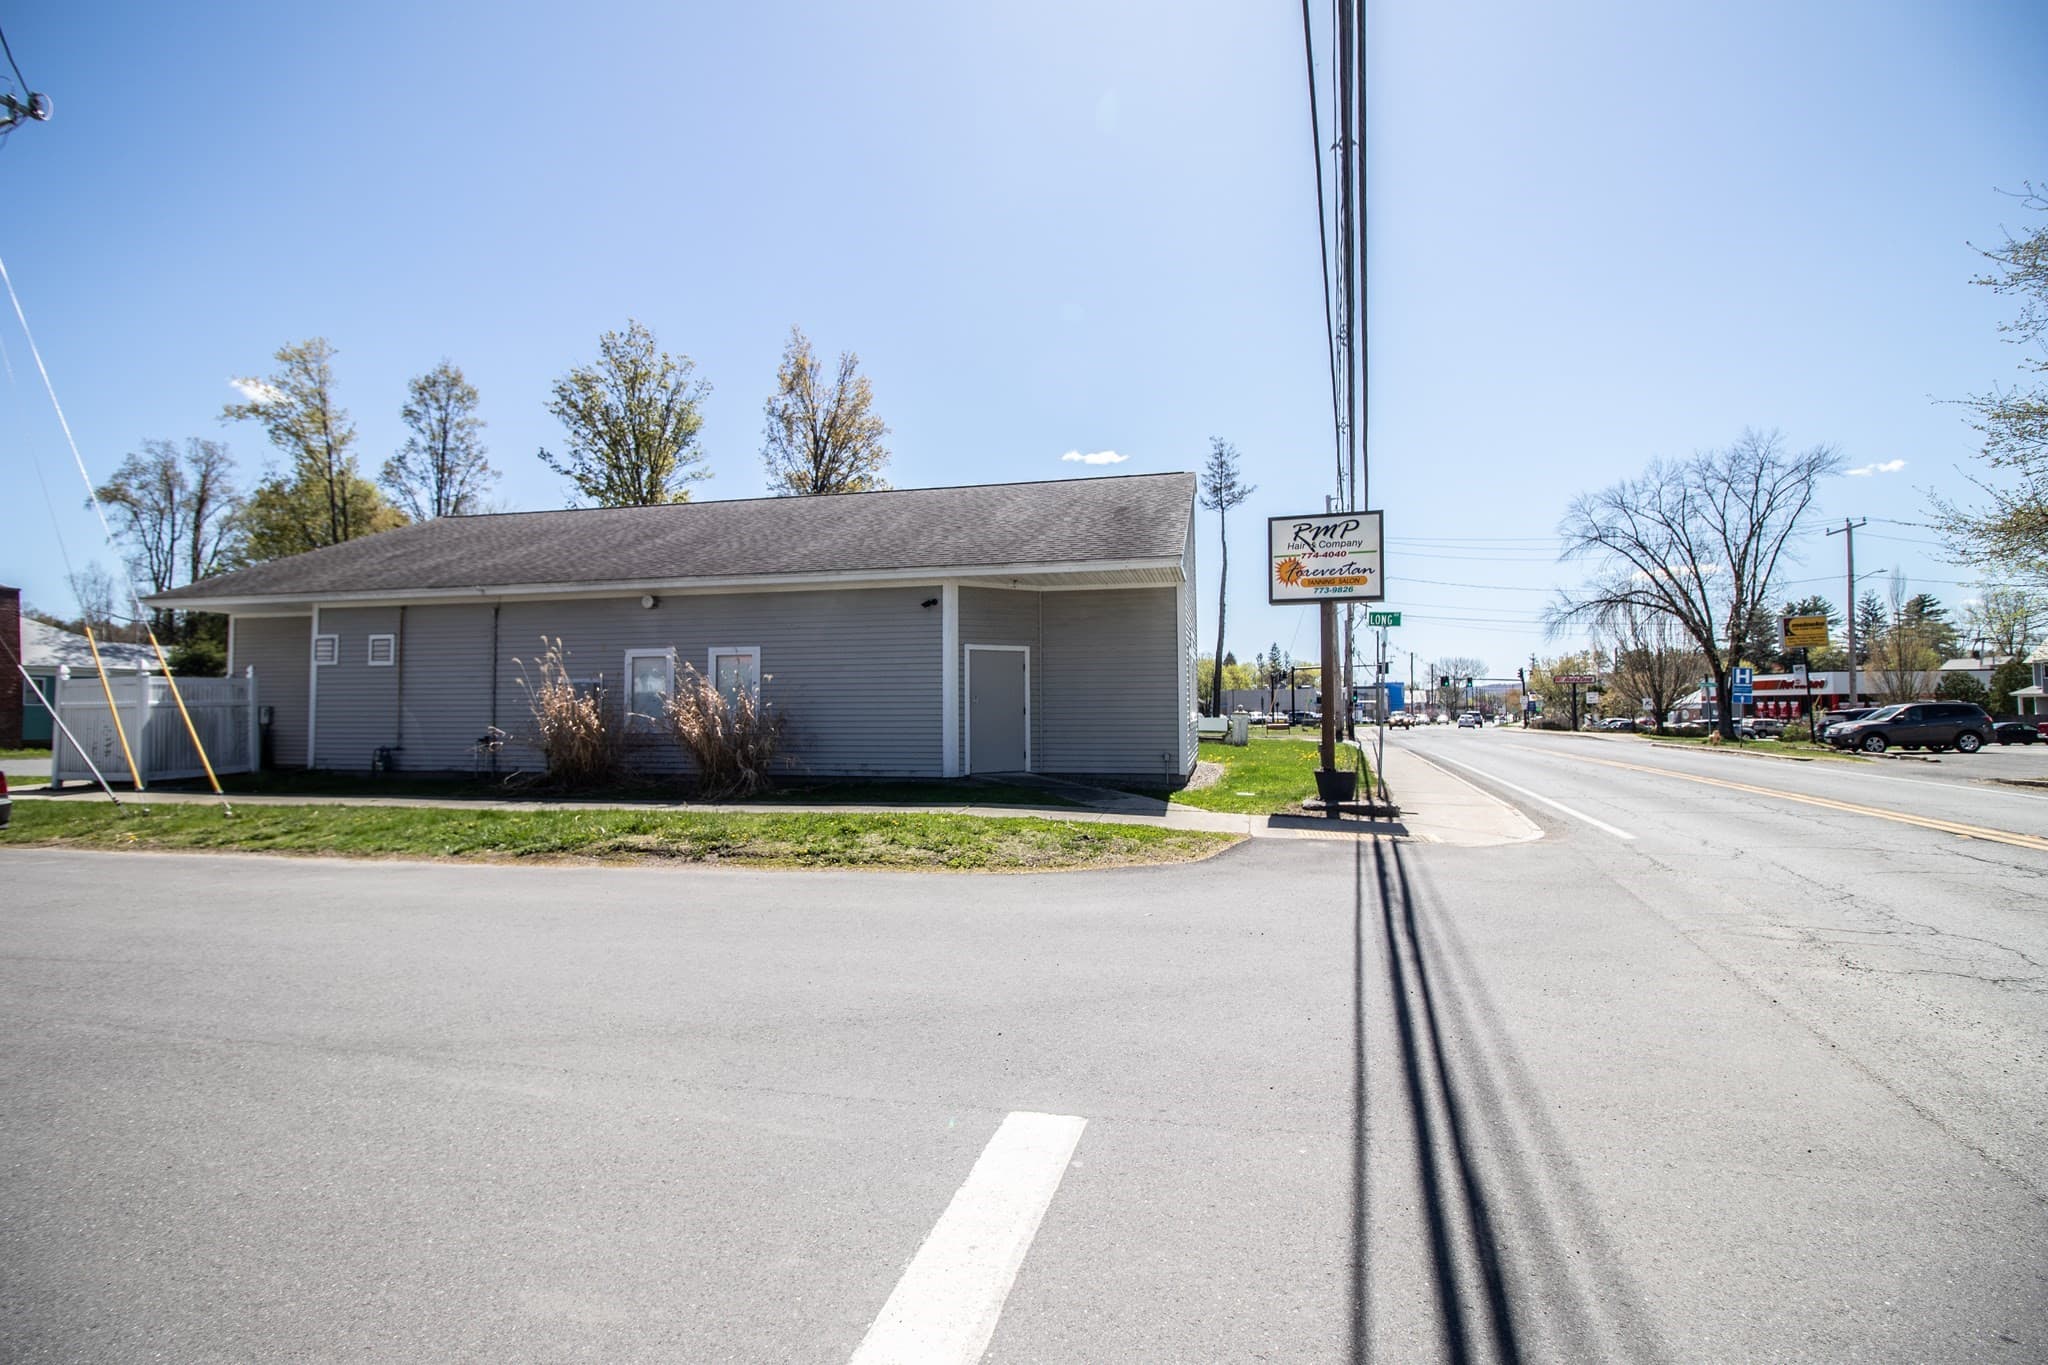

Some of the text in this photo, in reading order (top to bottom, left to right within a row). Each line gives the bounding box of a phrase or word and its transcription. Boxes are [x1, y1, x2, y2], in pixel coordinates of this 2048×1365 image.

[1293, 519, 1360, 552] RMP
[1287, 541, 1306, 551] Hair
[1318, 539, 1363, 551] Company
[1301, 550, 1347, 559] 774-4040
[1307, 577, 1361, 586] TANNING SALON
[1313, 586, 1354, 594] 773-9826
[1370, 614, 1393, 625] LONG
[1735, 669, 1750, 683] H
